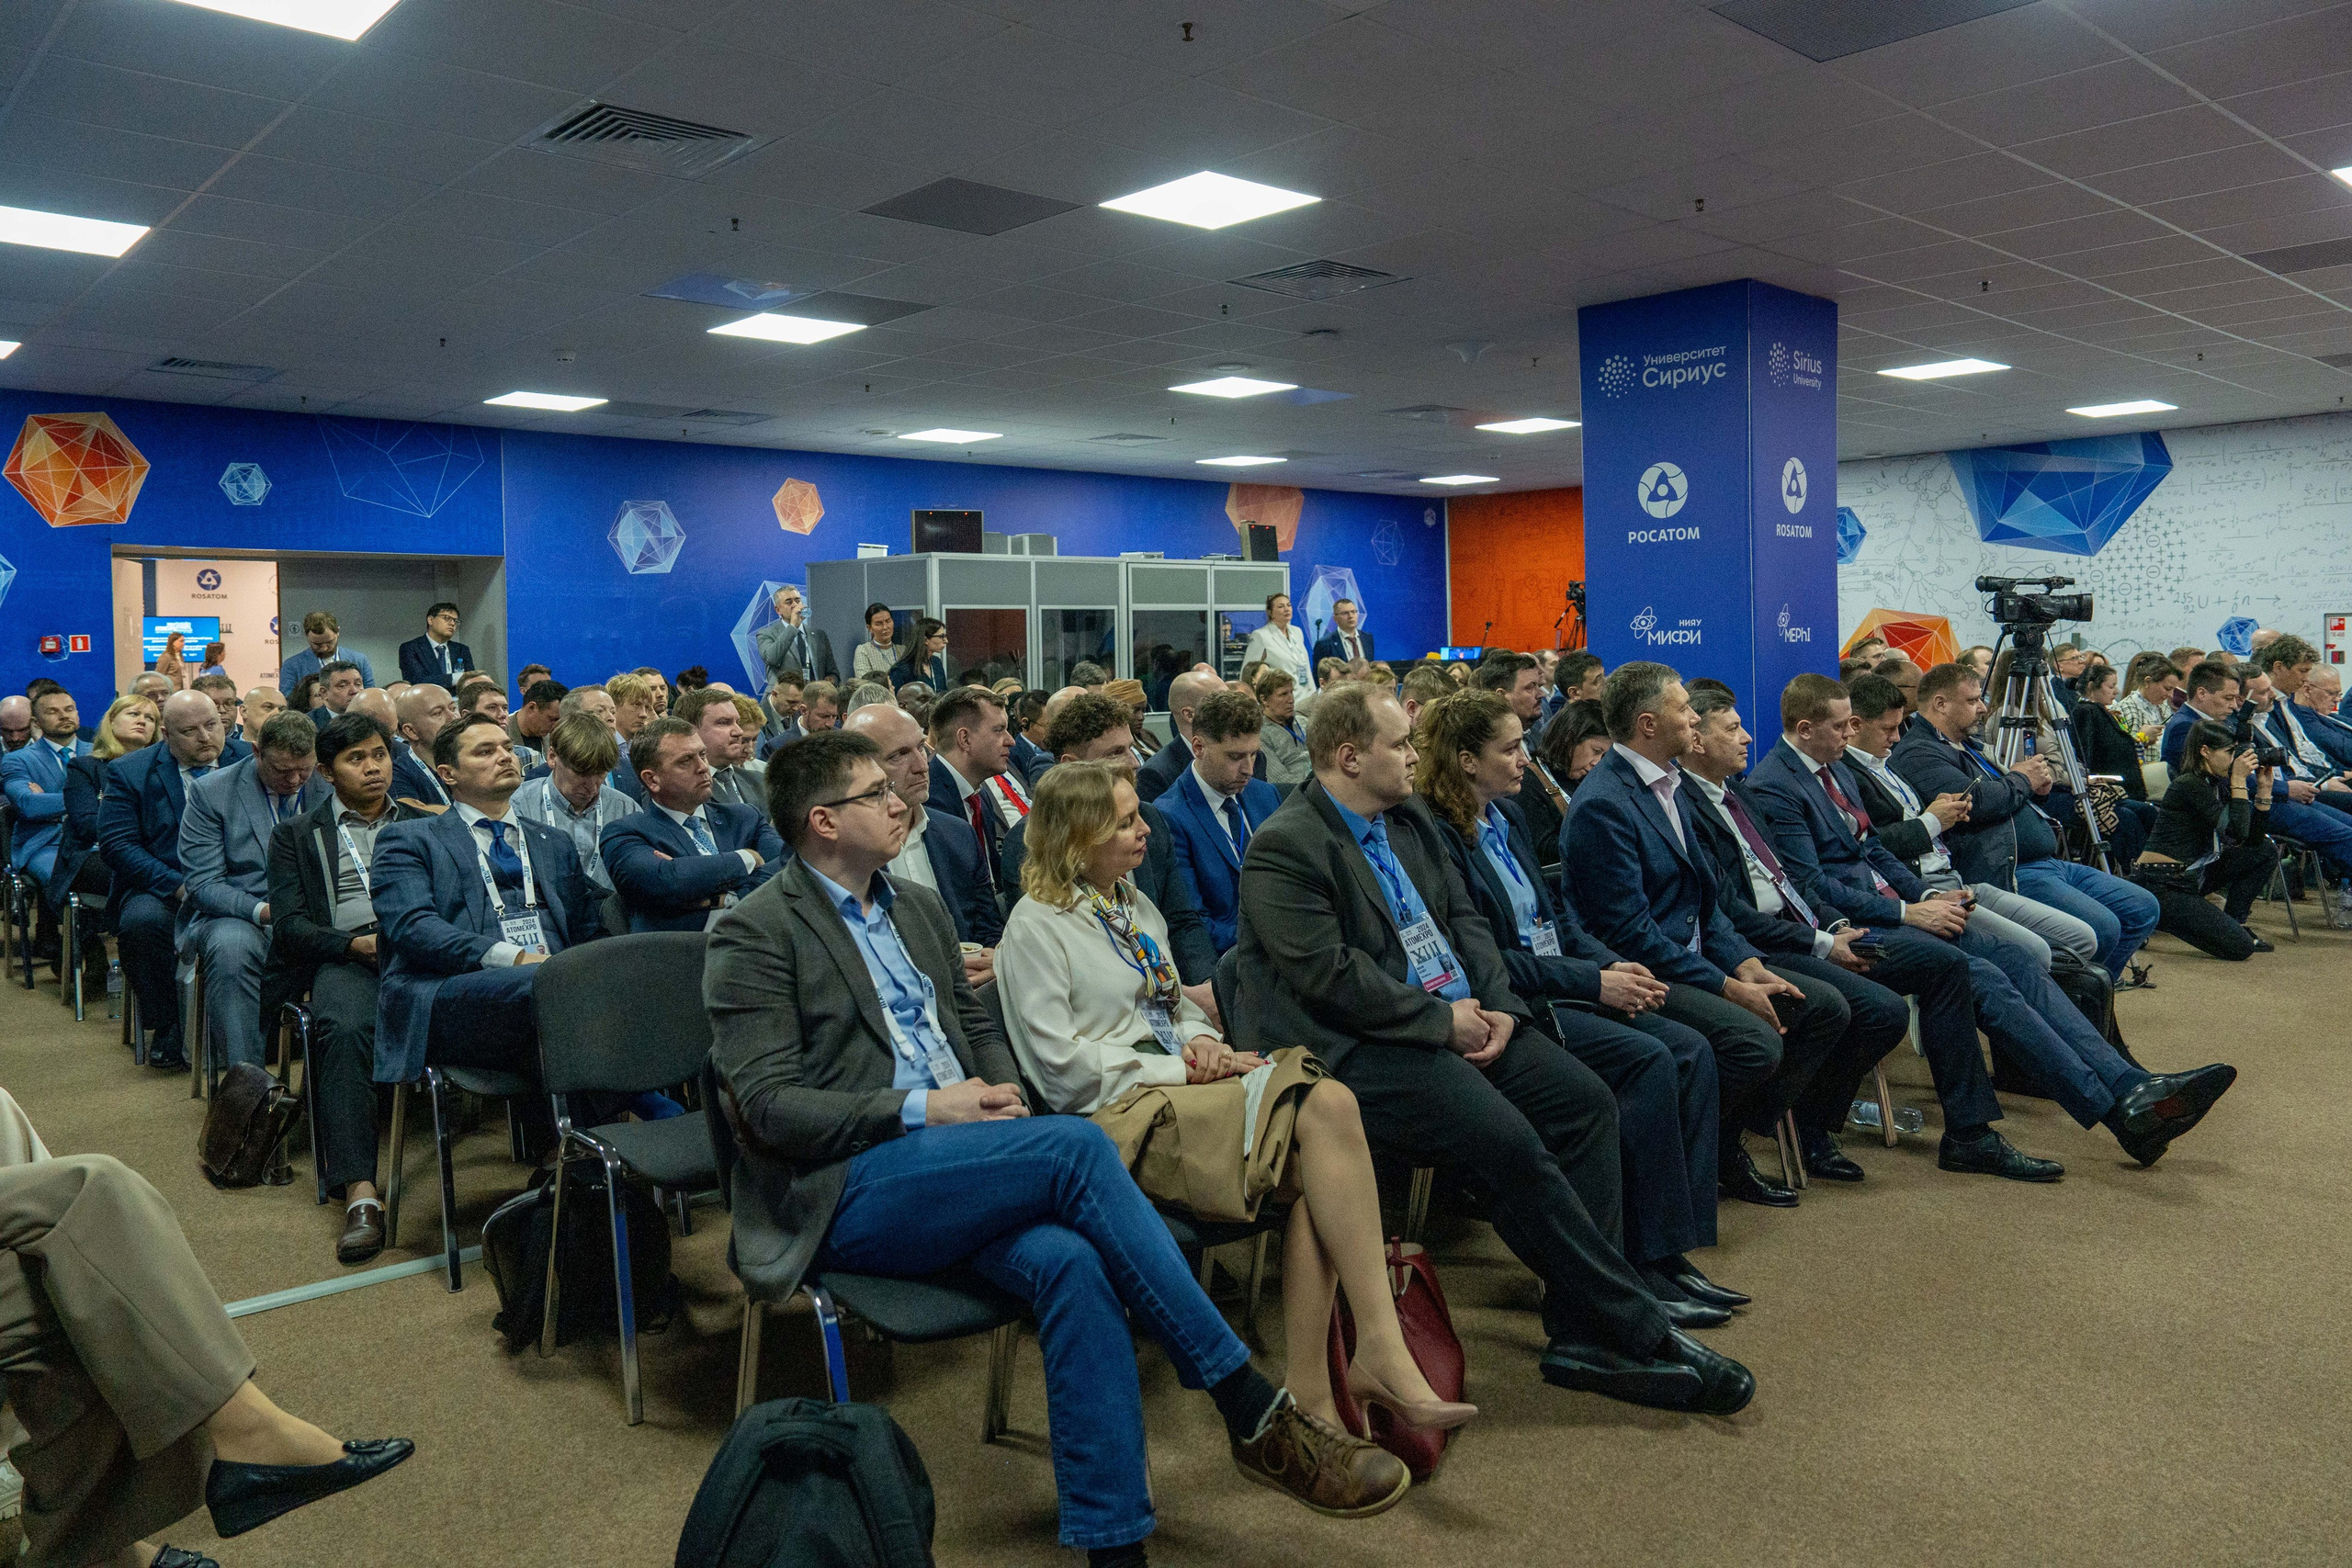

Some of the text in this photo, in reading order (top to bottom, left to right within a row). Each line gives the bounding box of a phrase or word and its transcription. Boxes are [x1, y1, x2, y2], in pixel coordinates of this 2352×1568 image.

[1643, 345, 1726, 367] Университет
[1793, 350, 1822, 374] Sirius
[1642, 362, 1726, 389] Сириус
[1793, 373, 1822, 390] University
[1628, 526, 1700, 544] РОСАТОМ
[1776, 524, 1813, 538] ROSATOM
[1679, 619, 1702, 627] НИЯУ
[1647, 629, 1701, 646] МИФИ
[1784, 627, 1810, 642] MEPhI
[506, 923, 537, 933] ATOMEXPO
[1417, 922, 1430, 932] 2024
[1404, 929, 1434, 948] ATOMEXPO
[1535, 938, 1555, 951] ATOMEXPO
